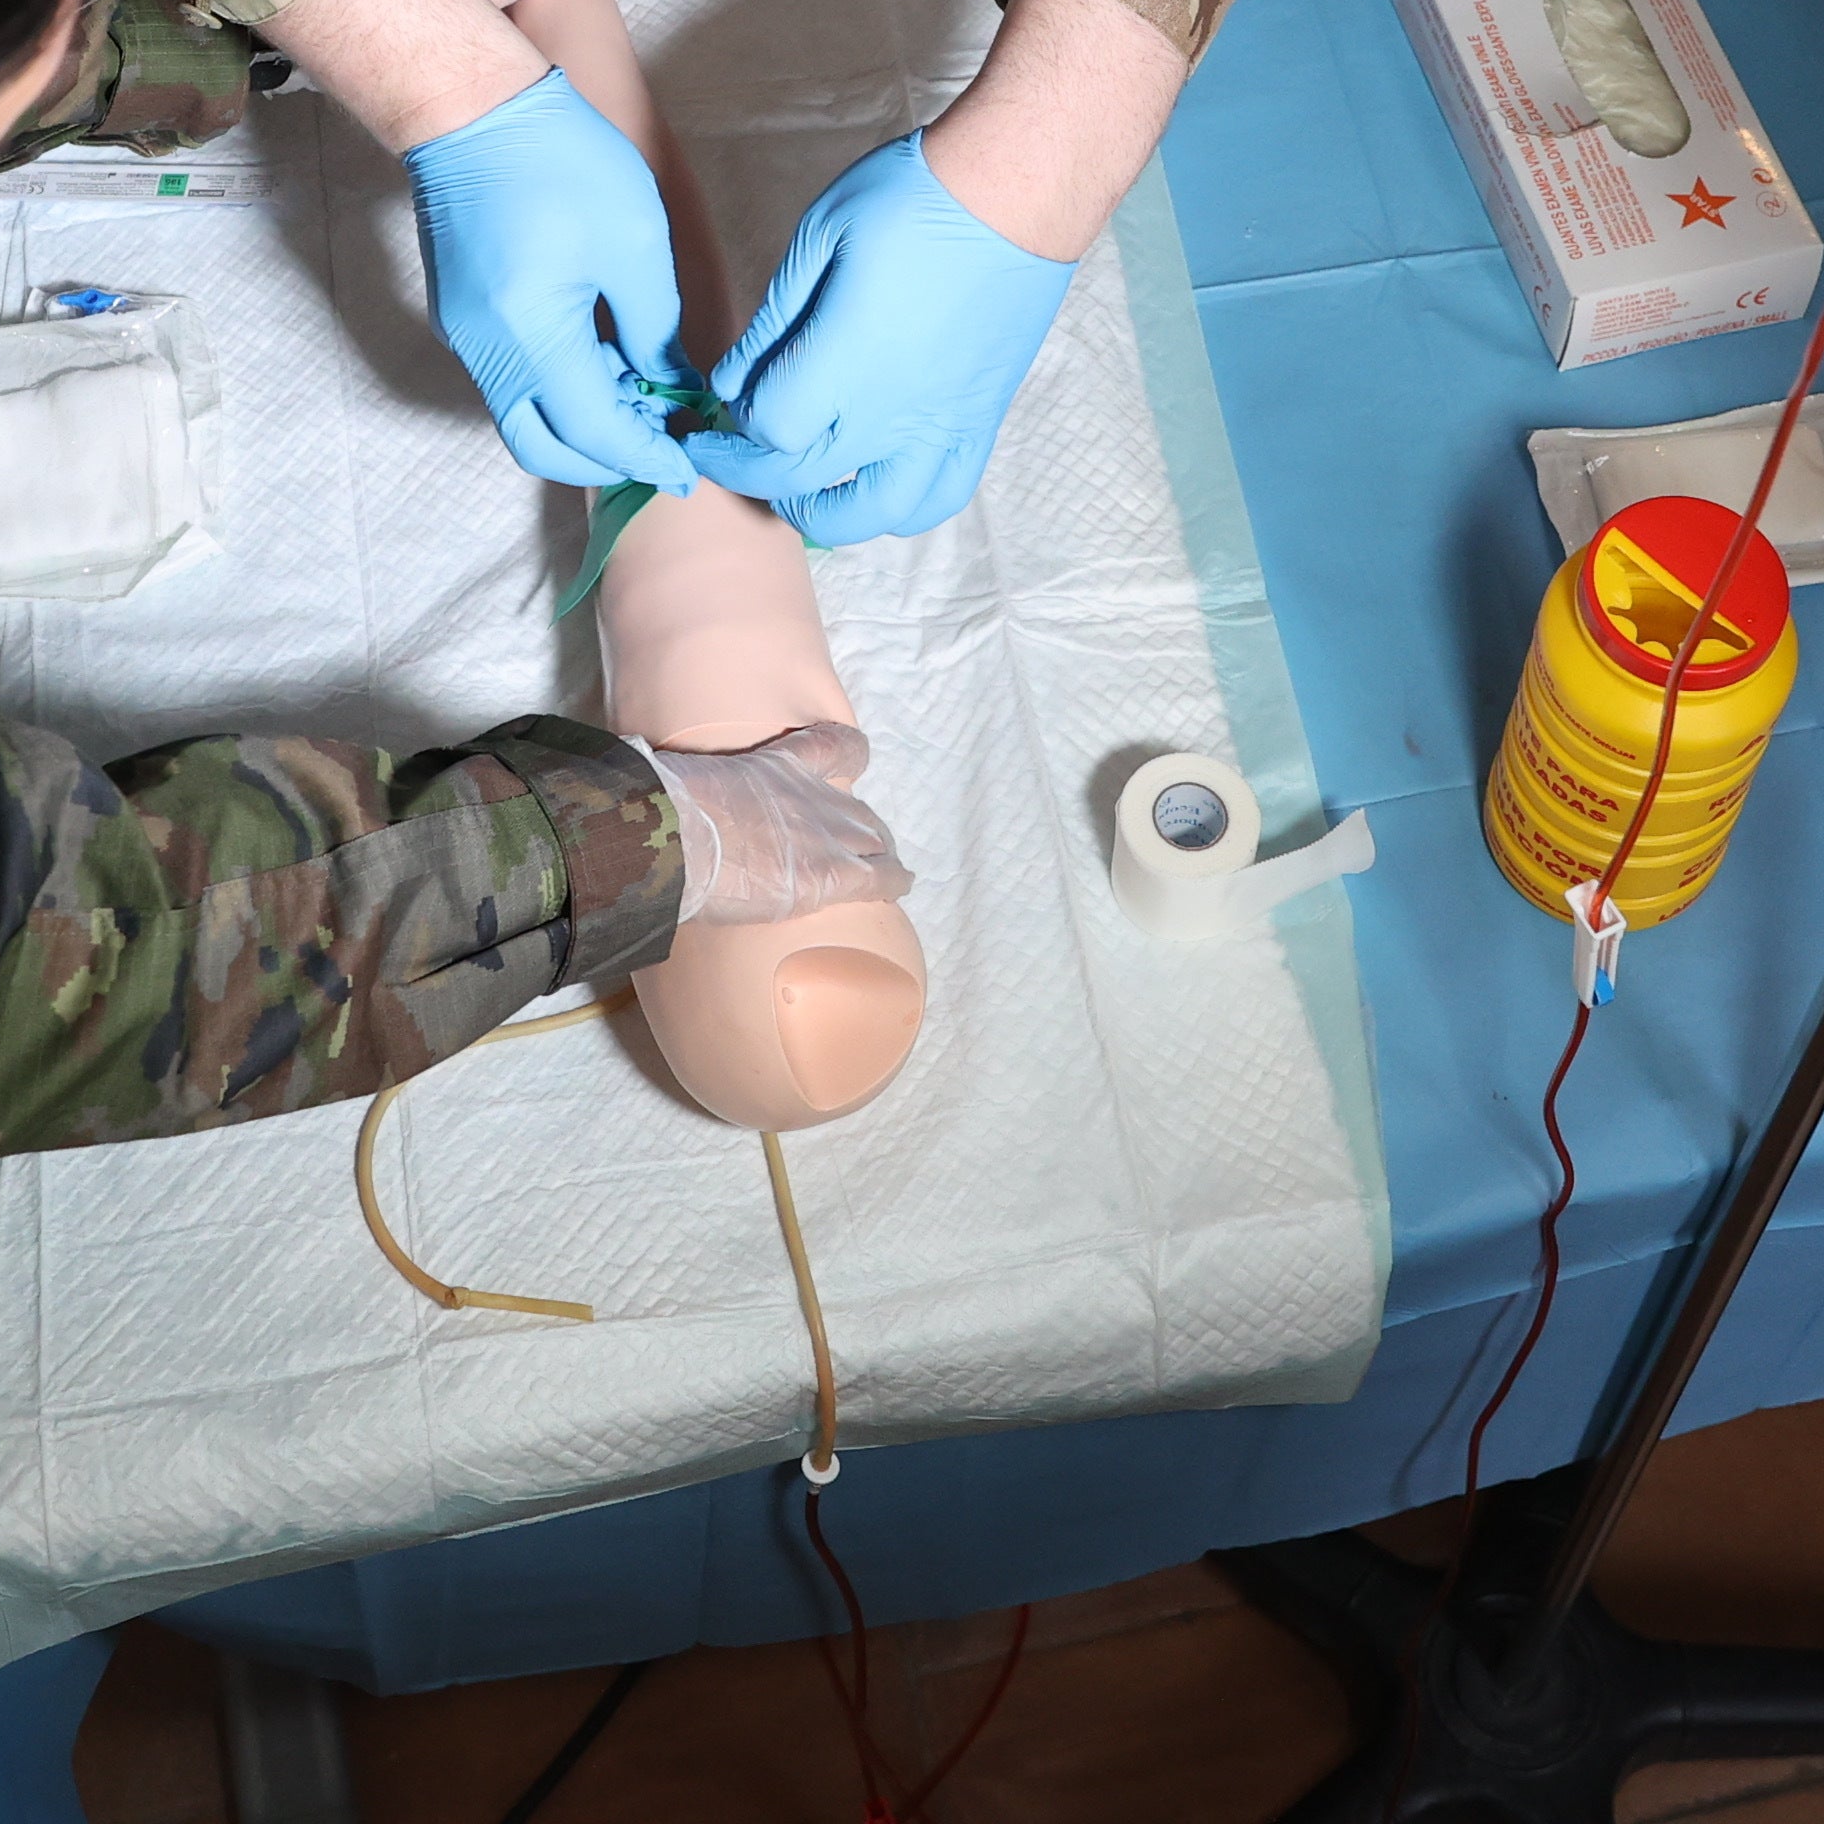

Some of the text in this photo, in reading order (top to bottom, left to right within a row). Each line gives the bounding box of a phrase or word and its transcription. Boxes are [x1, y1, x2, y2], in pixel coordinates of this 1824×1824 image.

[1466, 33, 1491, 65] VINILE
[1481, 66, 1508, 99] ESAME
[1518, 97, 1543, 122] EXAM
[1530, 167, 1561, 210] EXAMEN
[1562, 184, 1589, 220] EXAME
[1688, 192, 1719, 217] STAR
[1550, 212, 1584, 259] GUANTES
[1579, 221, 1606, 254] LUVAS
[1733, 286, 1772, 310] CE
[1581, 344, 1628, 363] PICCOLA
[1752, 309, 1788, 326] SMALL
[1546, 757, 1620, 811] PARA
[1533, 831, 1603, 878] POR
